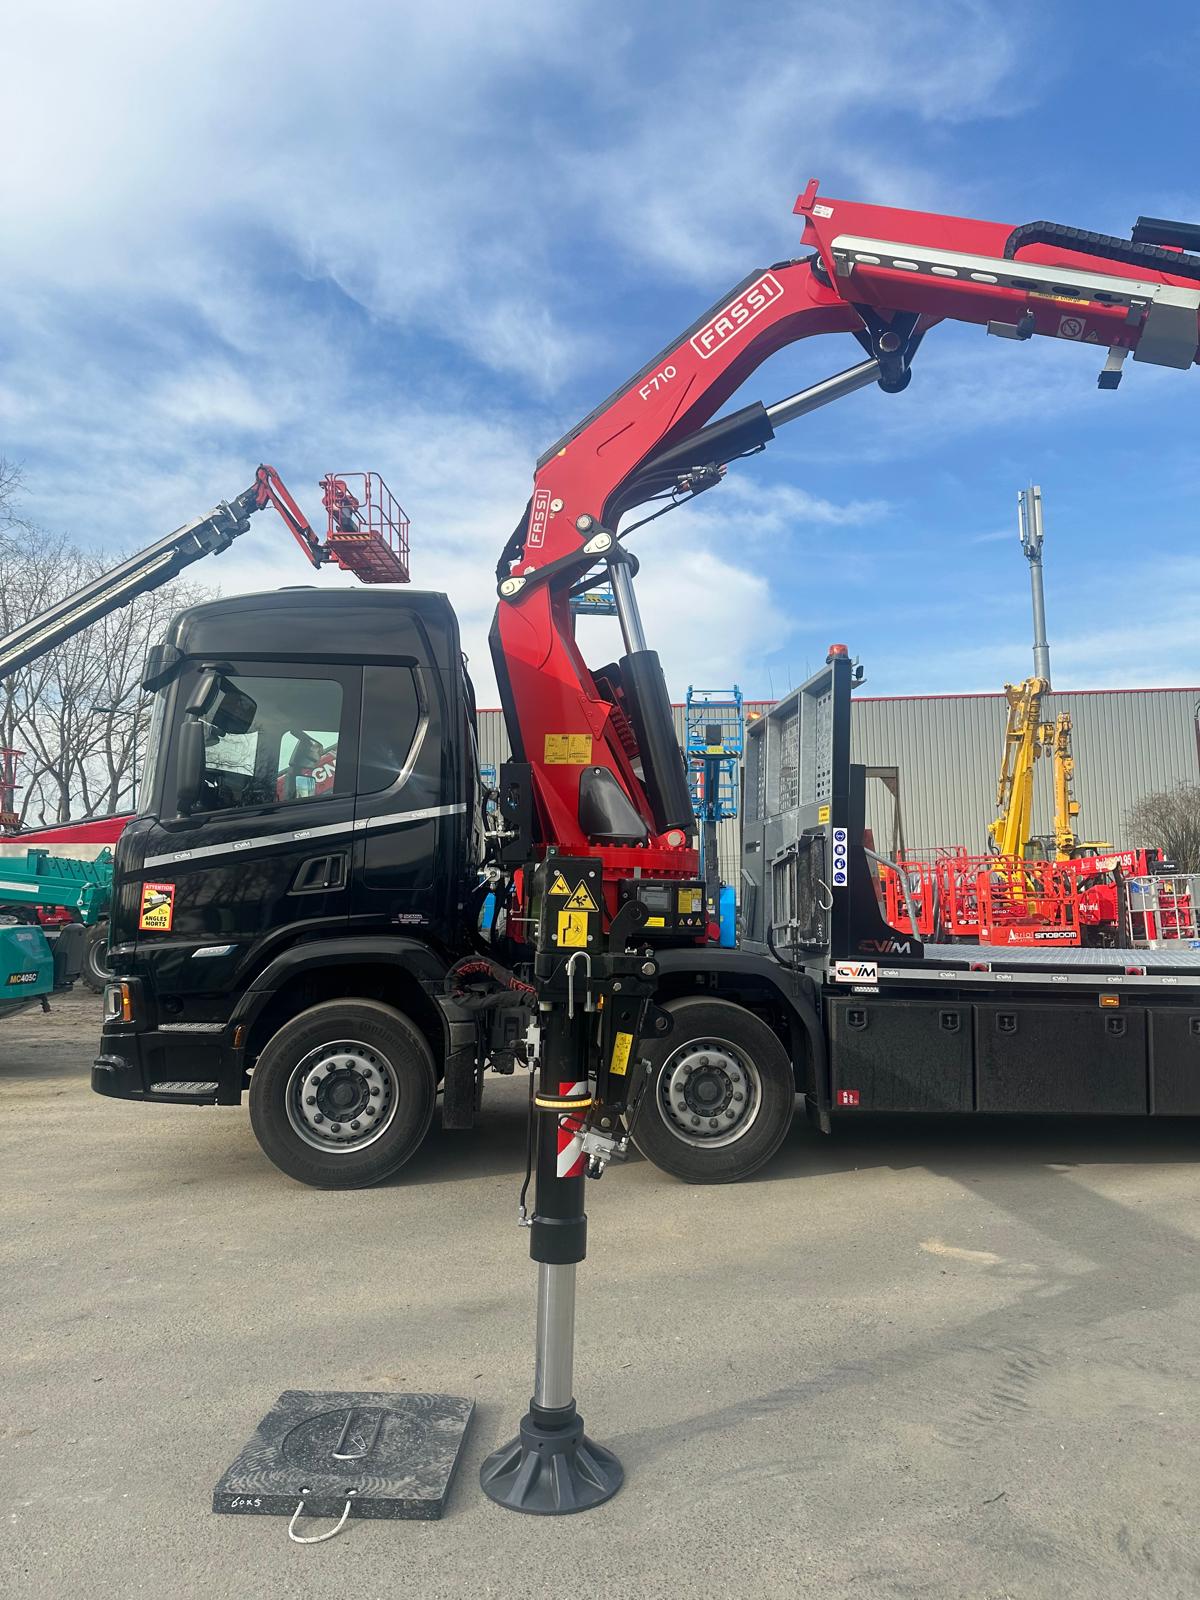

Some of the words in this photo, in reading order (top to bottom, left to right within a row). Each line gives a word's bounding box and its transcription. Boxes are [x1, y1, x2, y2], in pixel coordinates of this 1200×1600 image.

[701, 283, 774, 350] FASSI
[638, 365, 677, 401] F710
[531, 494, 548, 543] FASSI
[9, 973, 37, 984] MC405C
